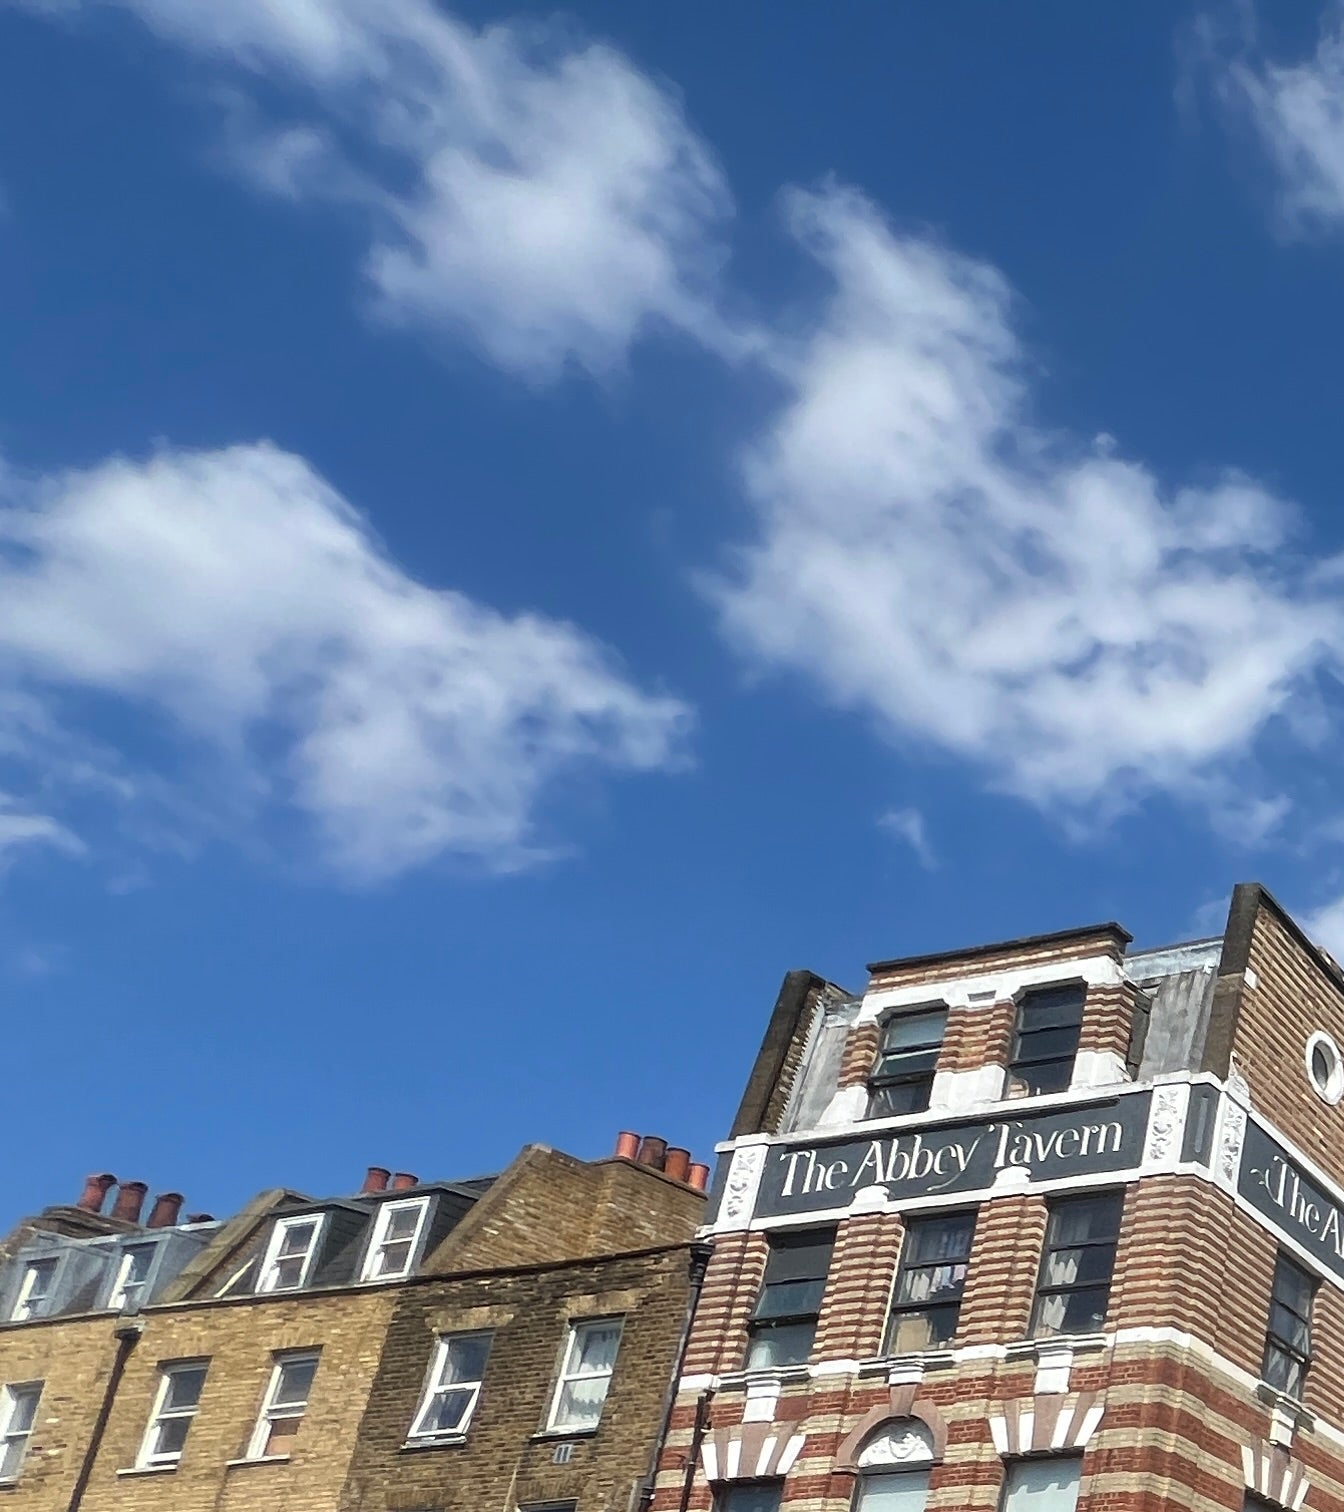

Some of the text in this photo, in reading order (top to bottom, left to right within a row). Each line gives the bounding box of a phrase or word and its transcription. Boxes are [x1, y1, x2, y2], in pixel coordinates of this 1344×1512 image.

[779, 1121, 1123, 1197] The Abbey Tavern
[1250, 1155, 1320, 1233] The
